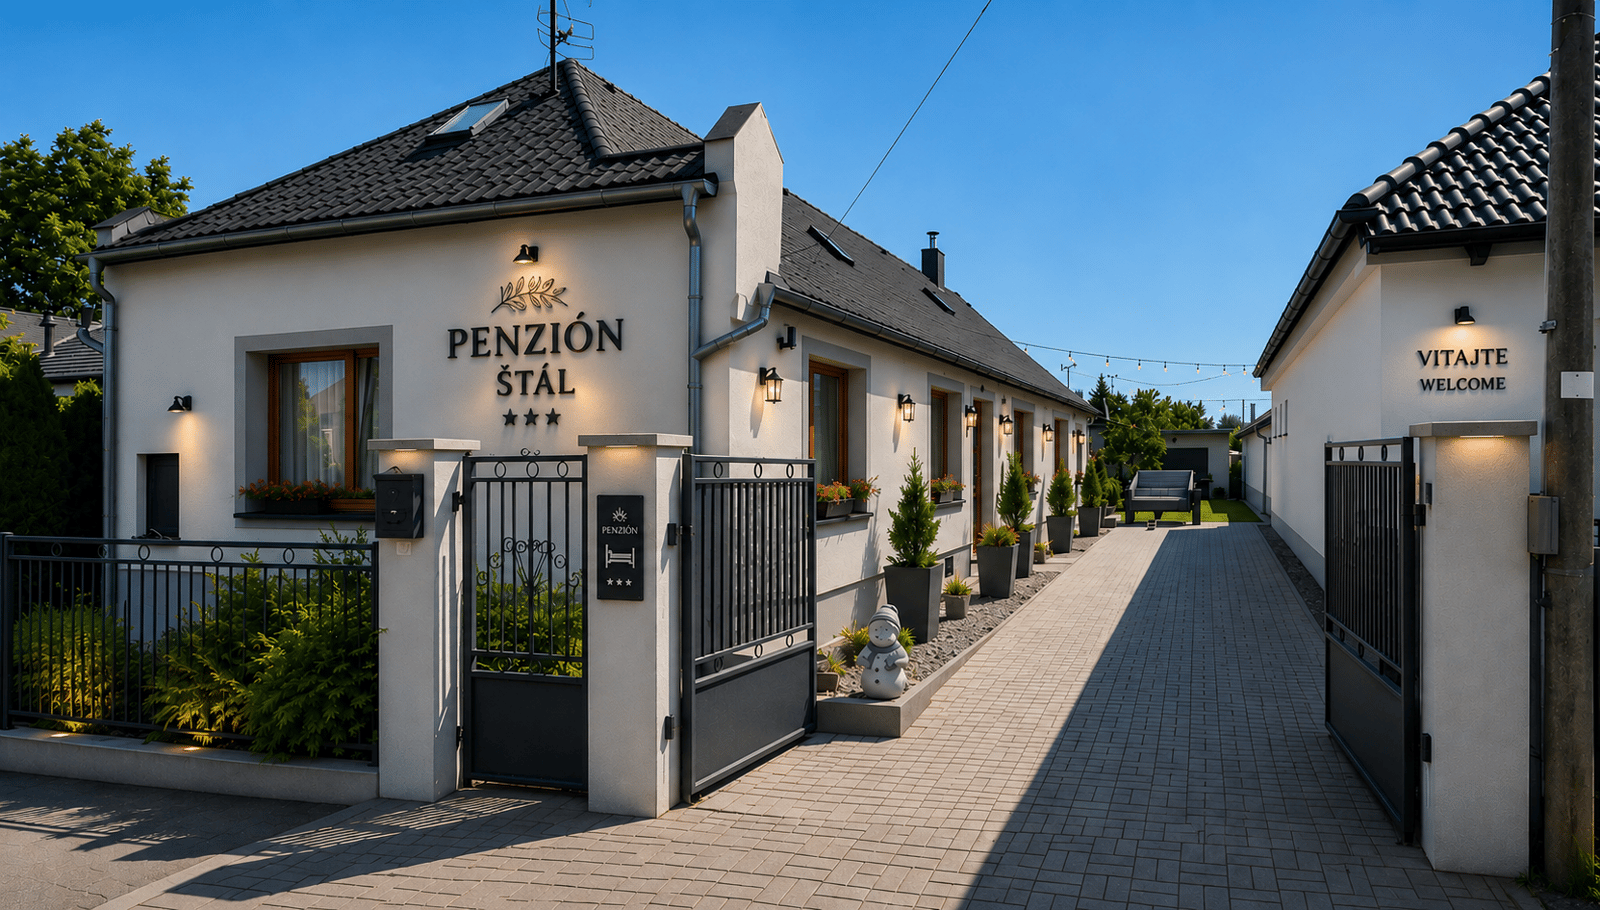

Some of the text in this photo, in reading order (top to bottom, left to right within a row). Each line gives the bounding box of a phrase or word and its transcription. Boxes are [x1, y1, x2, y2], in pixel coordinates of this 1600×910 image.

[447, 312, 624, 359] PENZIÓN
[1417, 348, 1508, 367] VITAJTE
[496, 363, 575, 397] ŠTÁL
[1420, 377, 1507, 391] WELCOME
[602, 525, 638, 535] PENZIÓN
